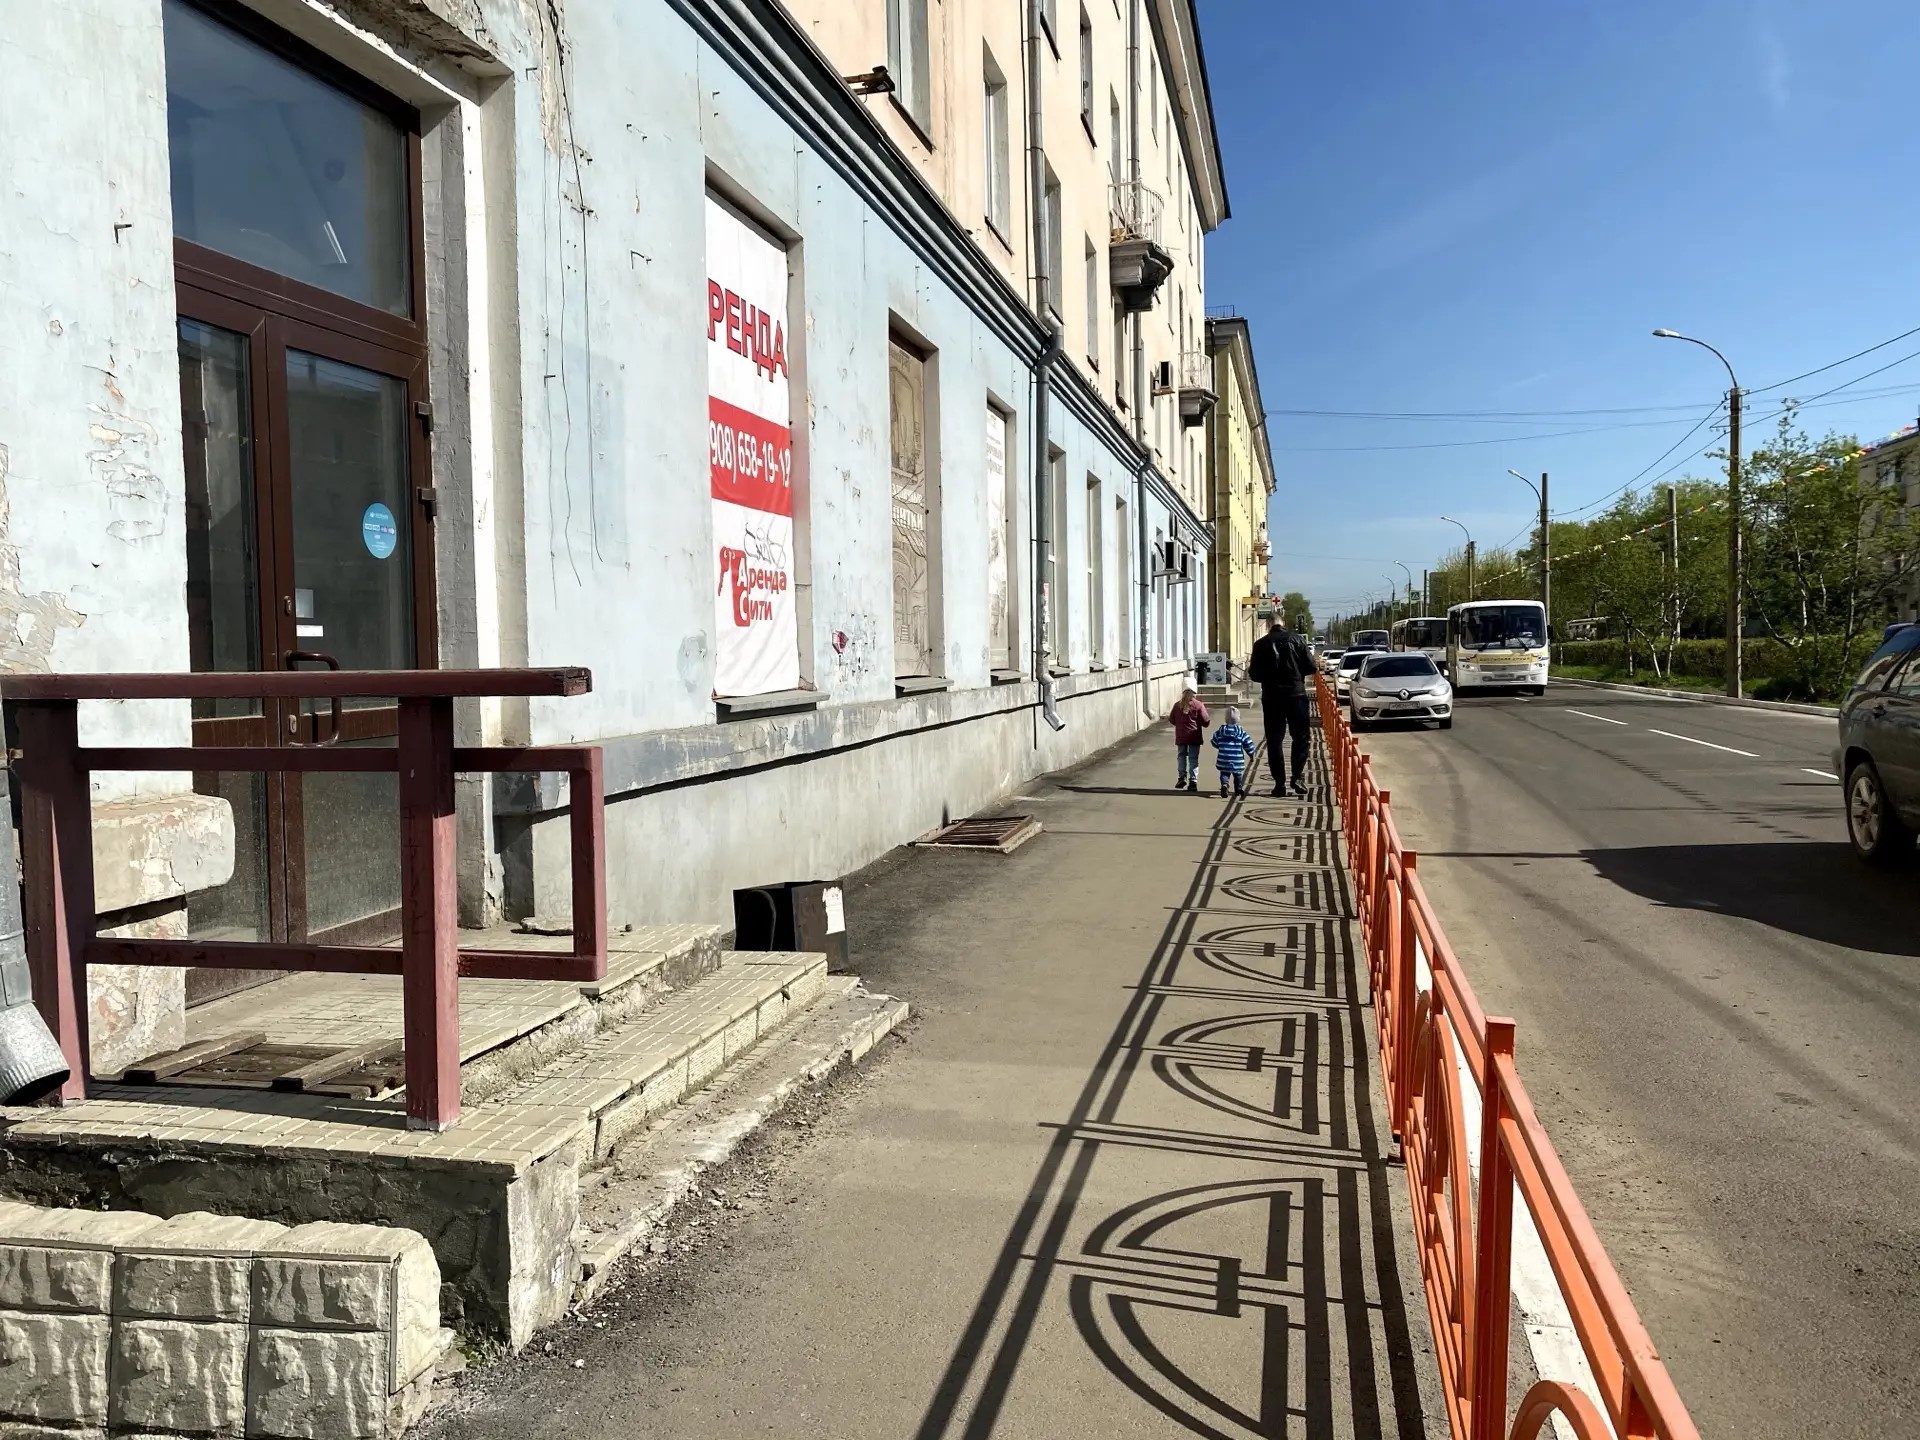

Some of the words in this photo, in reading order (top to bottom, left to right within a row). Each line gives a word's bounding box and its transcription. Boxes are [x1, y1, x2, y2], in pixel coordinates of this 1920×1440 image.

[707, 277, 788, 383] РЕНДА
[737, 430, 791, 488] 658-19-19
[737, 557, 787, 595] Аренда
[740, 589, 773, 622] Сити
